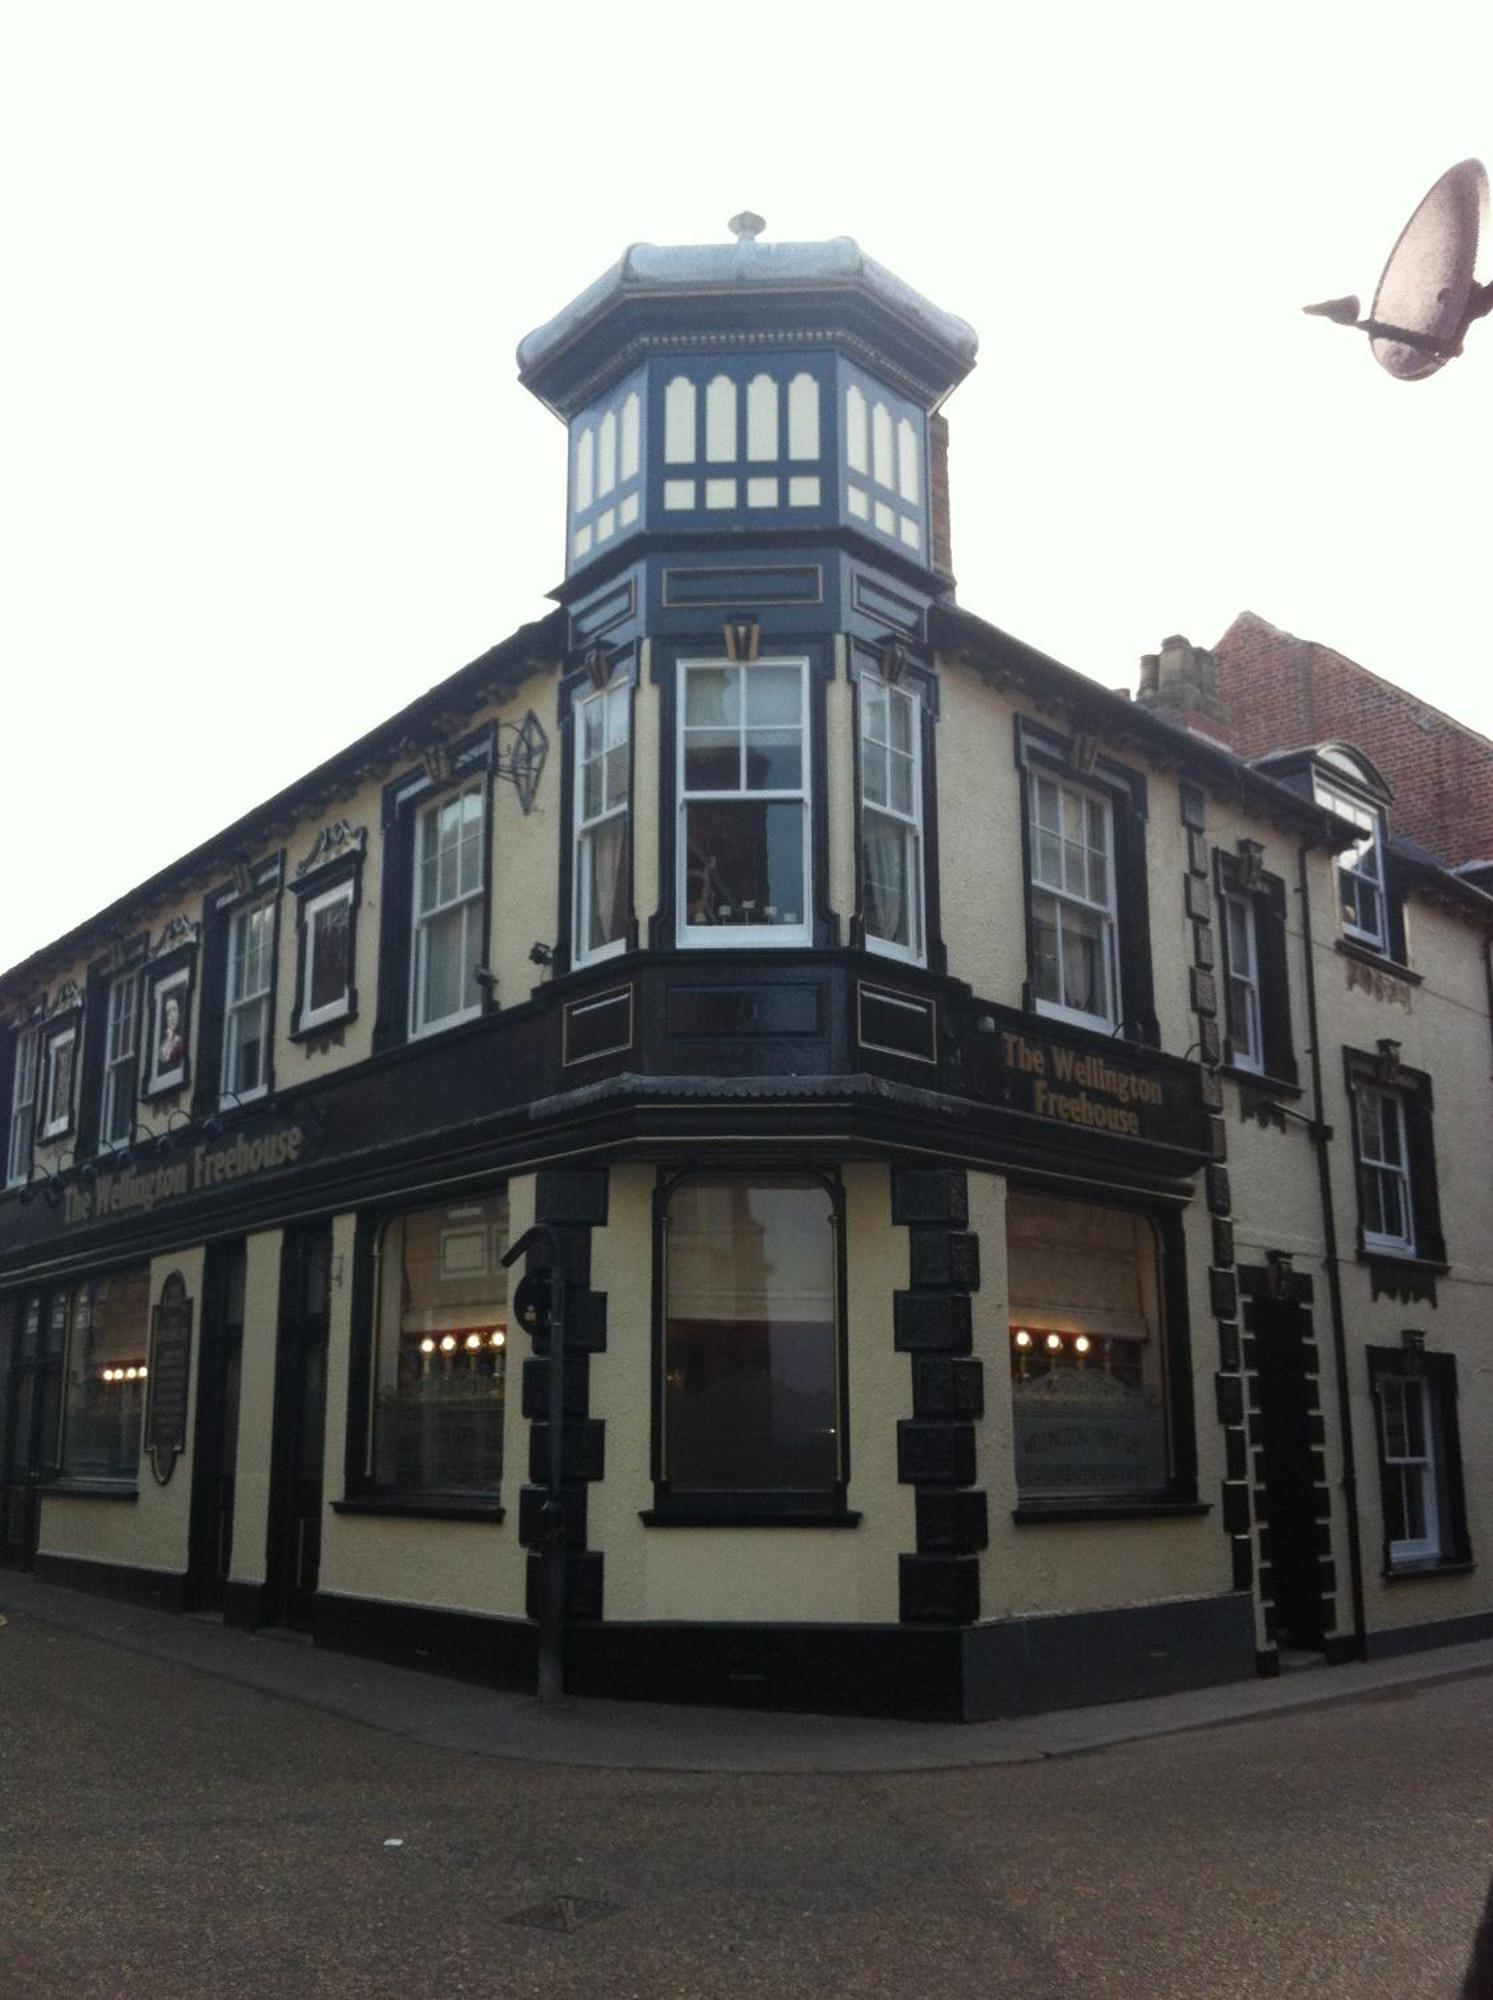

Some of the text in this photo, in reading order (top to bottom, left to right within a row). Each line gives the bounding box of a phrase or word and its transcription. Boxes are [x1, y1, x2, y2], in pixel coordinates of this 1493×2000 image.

[1002, 1031, 1162, 1104] The Wellington
[1034, 1081, 1139, 1134] Freehouse
[64, 1126, 302, 1223] The Wellington Freehouse
